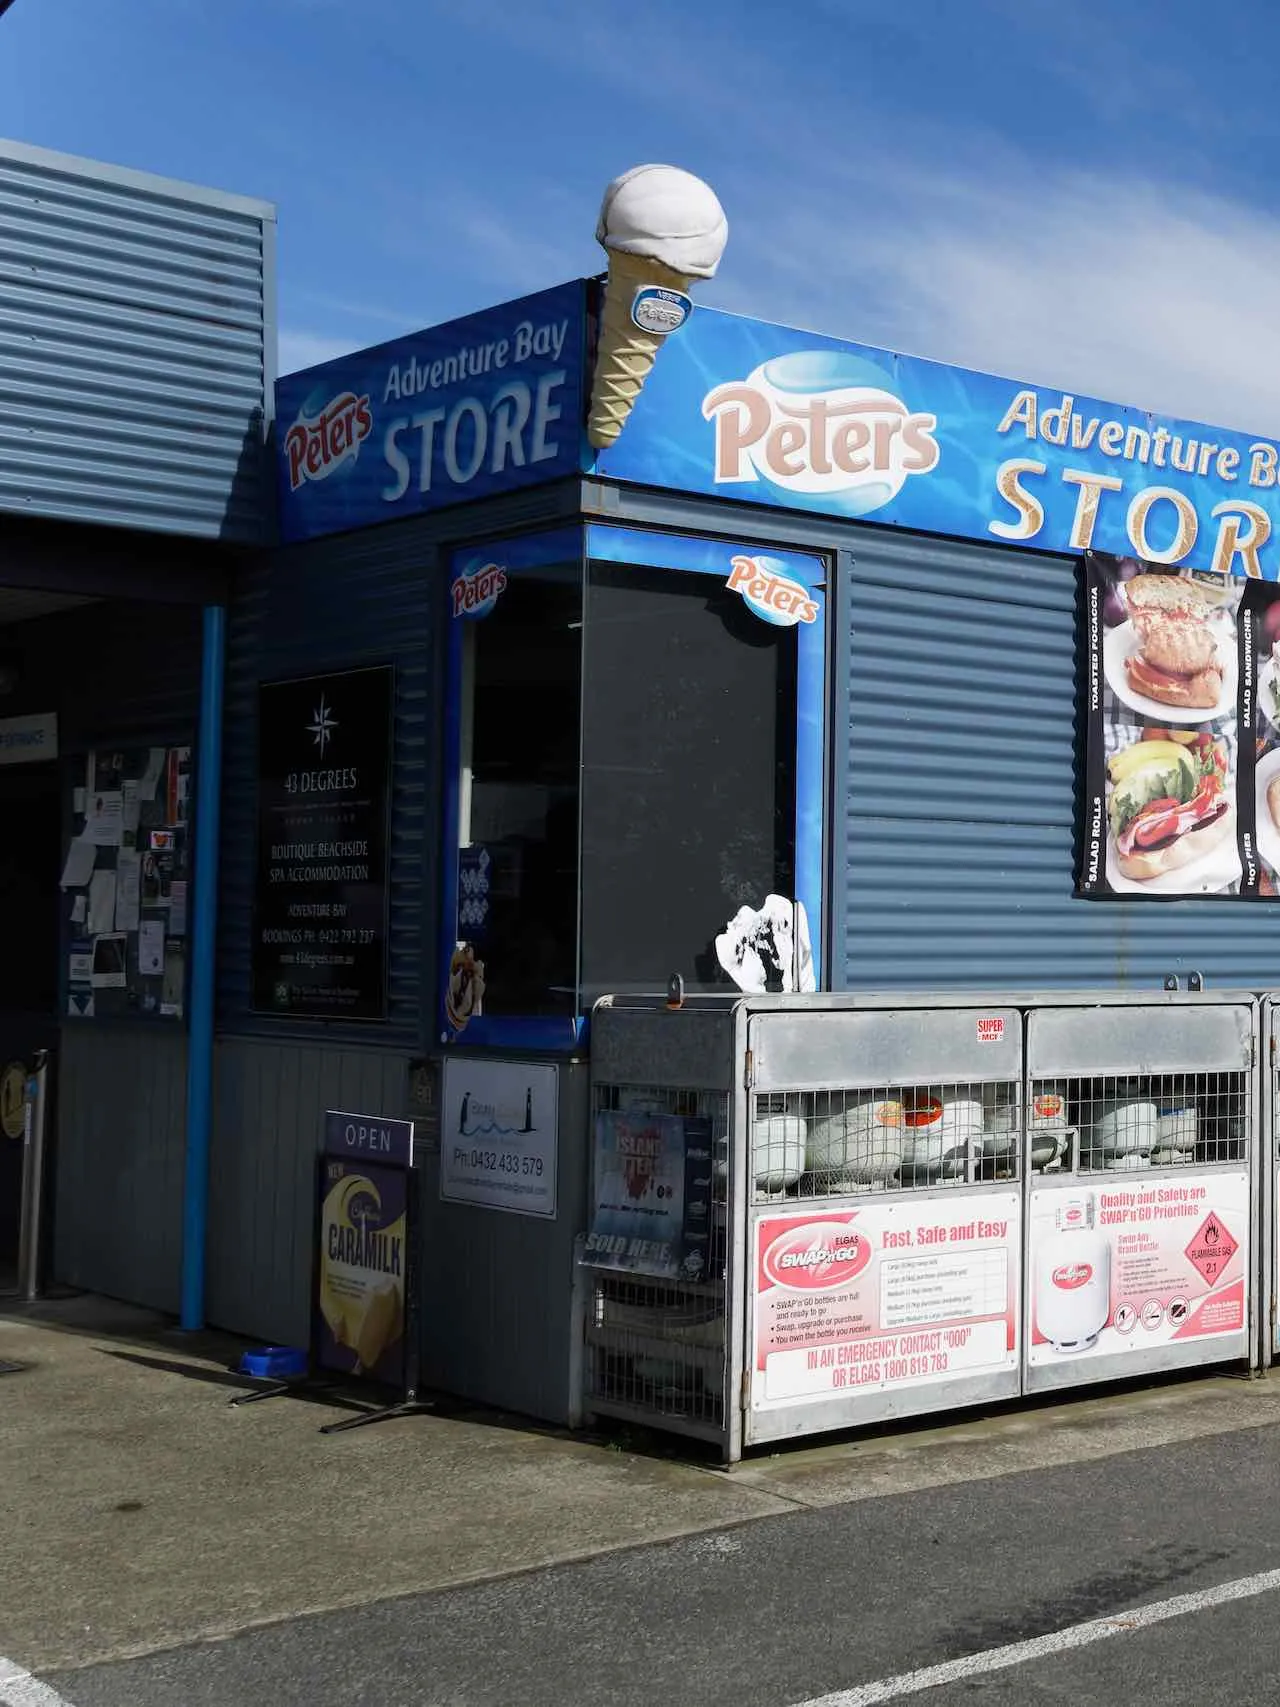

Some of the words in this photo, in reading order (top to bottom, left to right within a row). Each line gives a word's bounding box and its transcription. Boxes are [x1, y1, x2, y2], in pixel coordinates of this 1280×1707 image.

[639, 300, 681, 326] Peters
[383, 339, 509, 404] Adventure
[513, 319, 569, 361] Bay
[284, 391, 373, 491] Peters
[381, 369, 567, 501] STORE
[702, 380, 940, 483] Peters
[997, 389, 1241, 482] Adventure
[452, 564, 507, 618] Peters
[726, 555, 820, 624] Peters
[1244, 608, 1252, 687] SANDWICHES
[1091, 653, 1099, 711] TOASTED
[1243, 689, 1251, 729] SALAD
[283, 772, 298, 793] 43
[301, 767, 357, 793] DEGREES
[1092, 796, 1102, 837] ROLLS
[271, 843, 316, 861] BOUTIQUE
[318, 840, 369, 858] BEACHSIDE
[1088, 840, 1100, 882] SALAD
[1243, 832, 1253, 859] PIES
[269, 867, 285, 883] SPA
[288, 864, 369, 882] ACCOMMODATION
[1247, 861, 1256, 886] HOT
[978, 1019, 1003, 1033] SUPER
[345, 1123, 391, 1152] OPEN
[499, 1153, 520, 1173] 433
[522, 1157, 544, 1177] 579
[1100, 1192, 1136, 1209] Quality
[1138, 1190, 1155, 1204] and
[1157, 1187, 1188, 1203] Safety
[1190, 1186, 1206, 1200] are
[1153, 1203, 1199, 1220] Priorities
[328, 1222, 402, 1278] CARAMILK
[584, 1232, 626, 1253] SOLD
[835, 1234, 859, 1246] ELGAS
[882, 1229, 915, 1249] Fast,
[917, 1225, 946, 1245] Safe
[949, 1222, 975, 1242] and
[978, 1220, 1008, 1239] Easy
[1205, 1262, 1217, 1274] 2.1
[807, 1350, 818, 1371] IN
[820, 1347, 834, 1369] AN
[838, 1341, 897, 1366] EMERGENCY
[899, 1332, 942, 1356] CONTACT
[832, 1367, 847, 1388] OR
[849, 1362, 880, 1385] ELGAS
[883, 1358, 908, 1380] 1800
[910, 1354, 929, 1376] 819
[931, 1352, 948, 1372] 783
